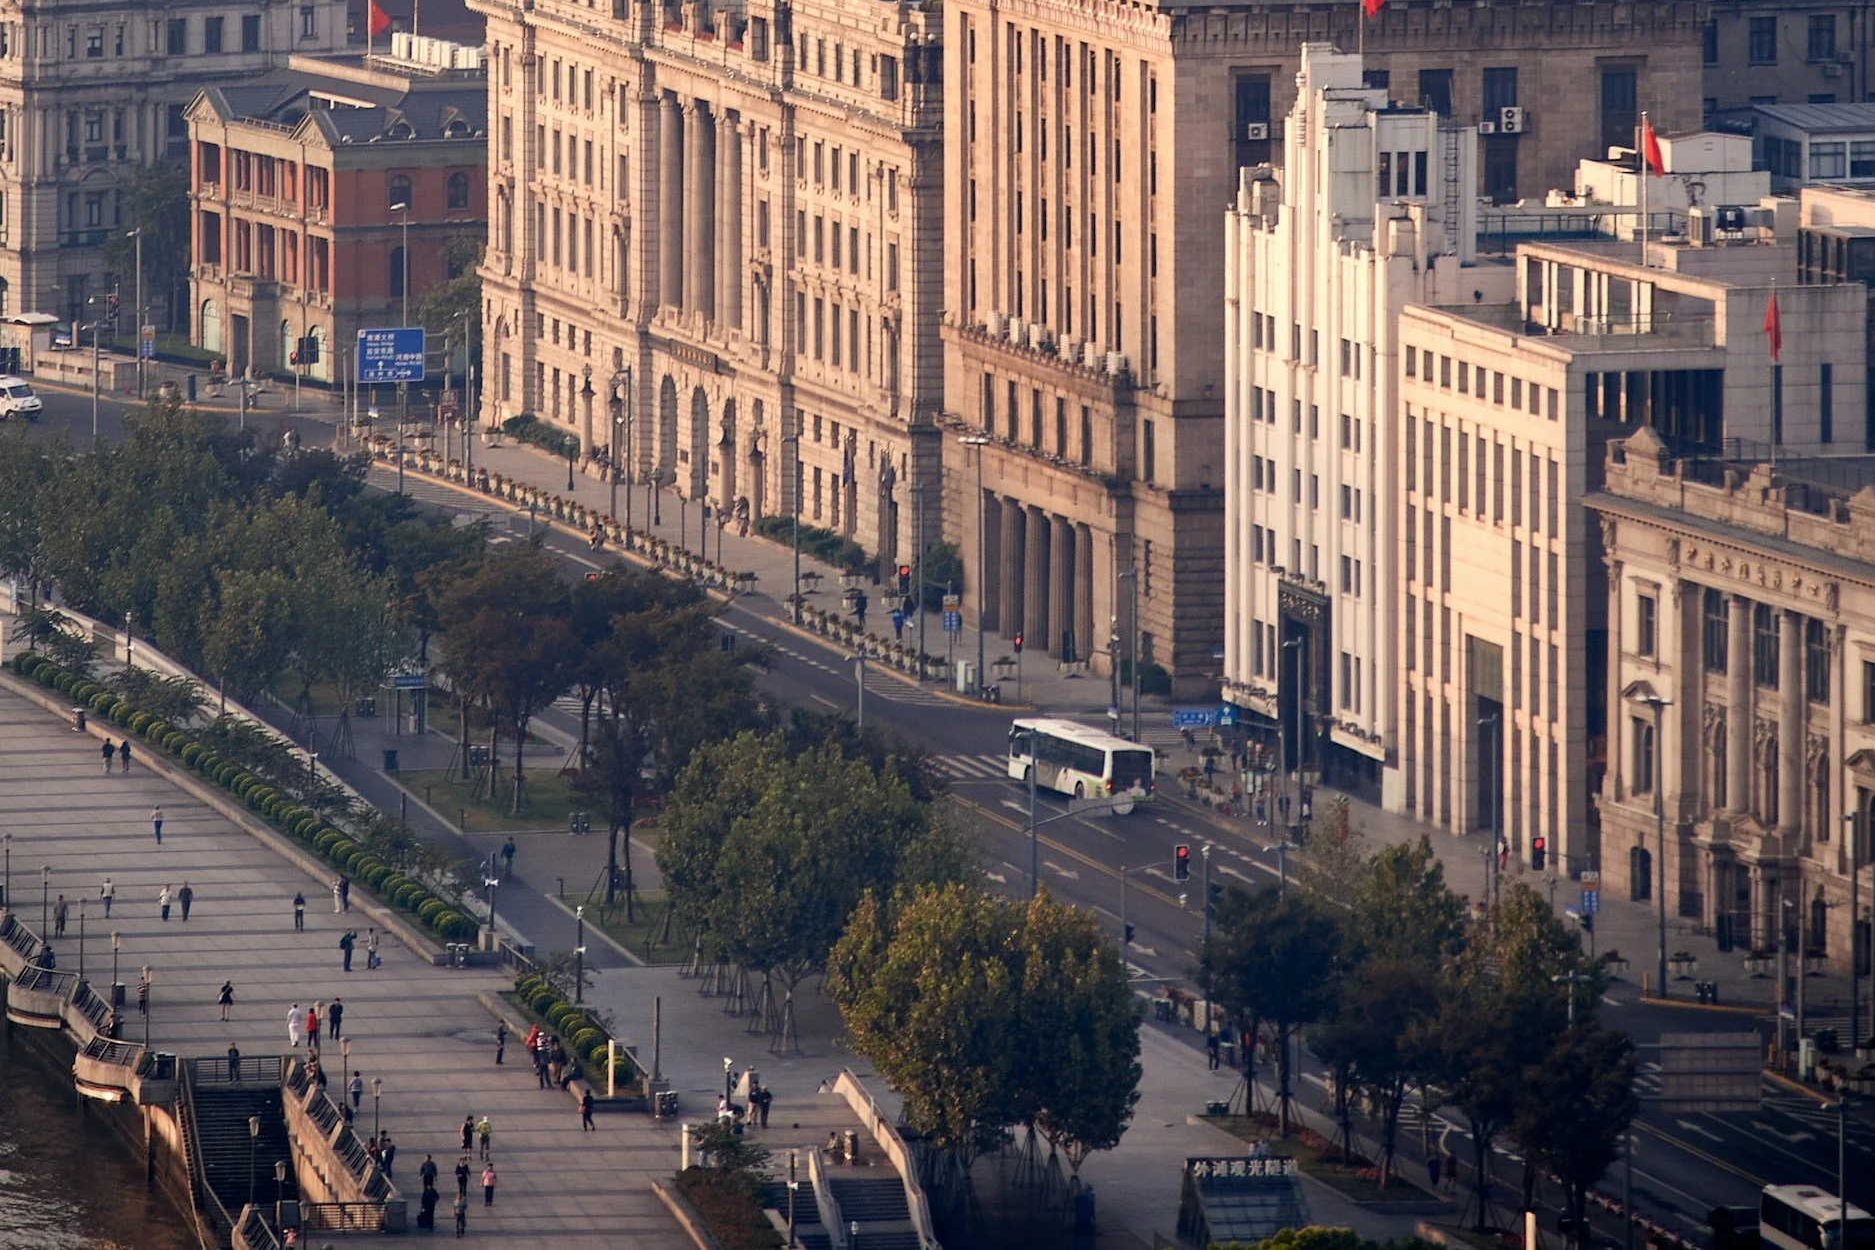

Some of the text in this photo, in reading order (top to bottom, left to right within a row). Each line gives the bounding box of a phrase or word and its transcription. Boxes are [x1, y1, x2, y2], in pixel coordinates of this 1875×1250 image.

[1193, 1159, 1299, 1178] 外滩观光隧道
